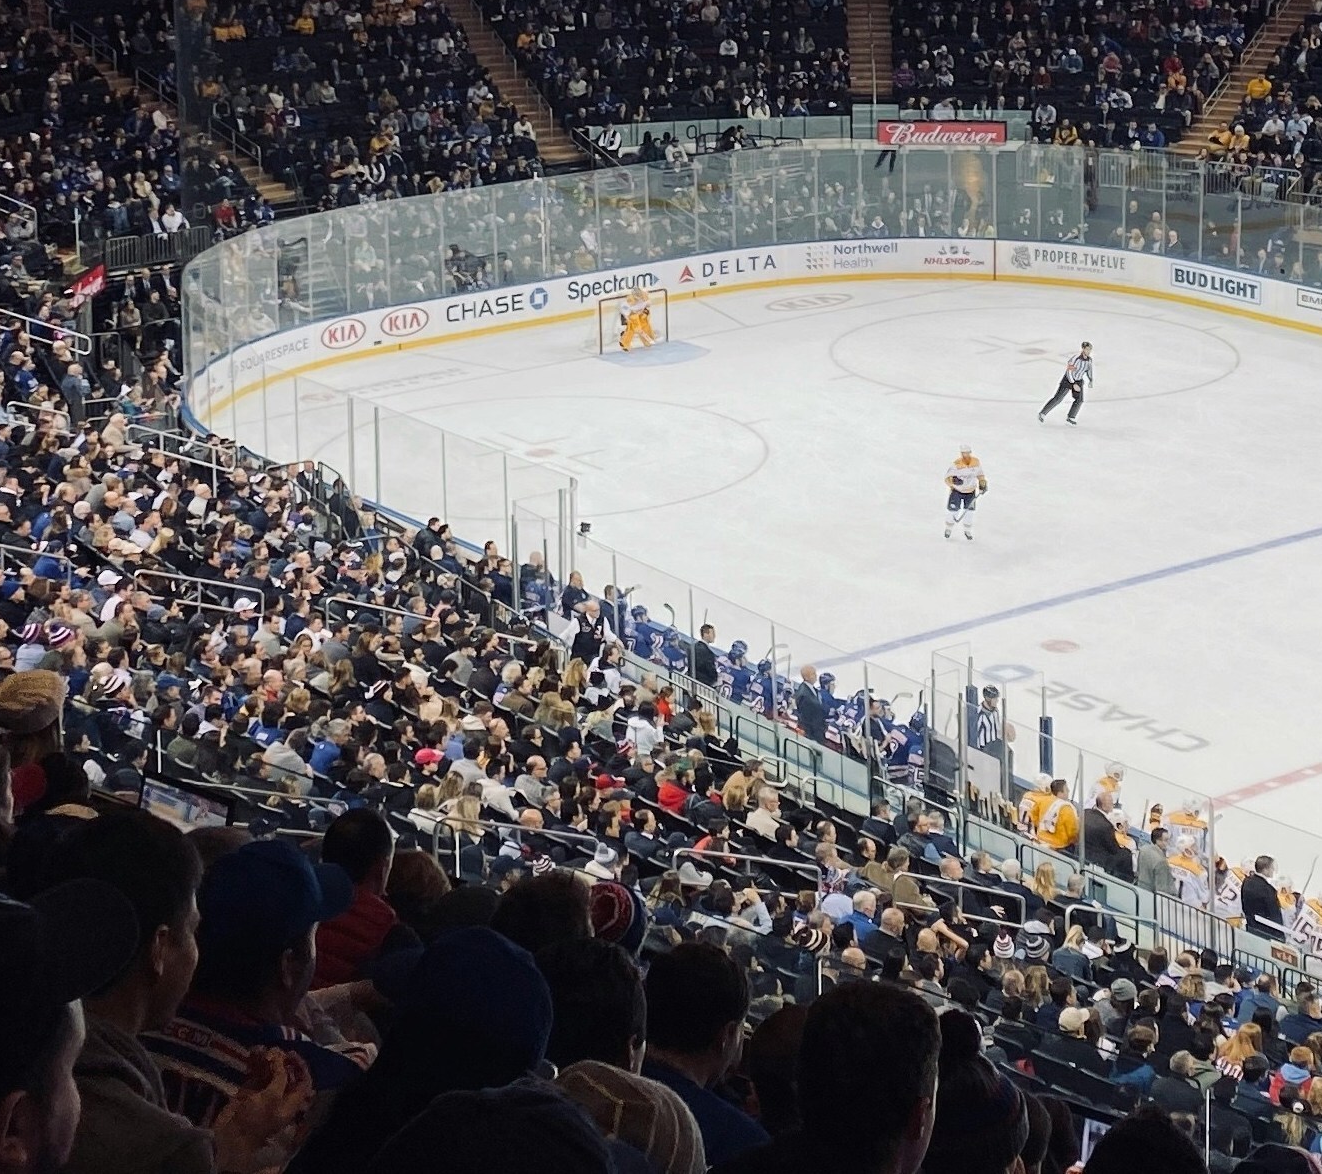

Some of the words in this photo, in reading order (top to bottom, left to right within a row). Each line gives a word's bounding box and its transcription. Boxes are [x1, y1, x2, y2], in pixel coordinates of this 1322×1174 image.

[885, 122, 999, 145] Budweiser
[832, 242, 899, 256] Northwell
[1033, 248, 1078, 266] PROPER
[1083, 254, 1127, 271] TWELVE
[701, 254, 777, 278] DELTA
[832, 257, 874, 270] Health
[566, 272, 654, 303] Spectrum
[1174, 268, 1210, 289] BUD
[1210, 276, 1259, 300] LIGHT
[387, 307, 422, 333] KIA
[445, 292, 525, 323] CHASE
[328, 324, 359, 344] KIA
[239, 337, 311, 374] SQUARESPACE
[1025, 680, 1212, 753] CHASE
